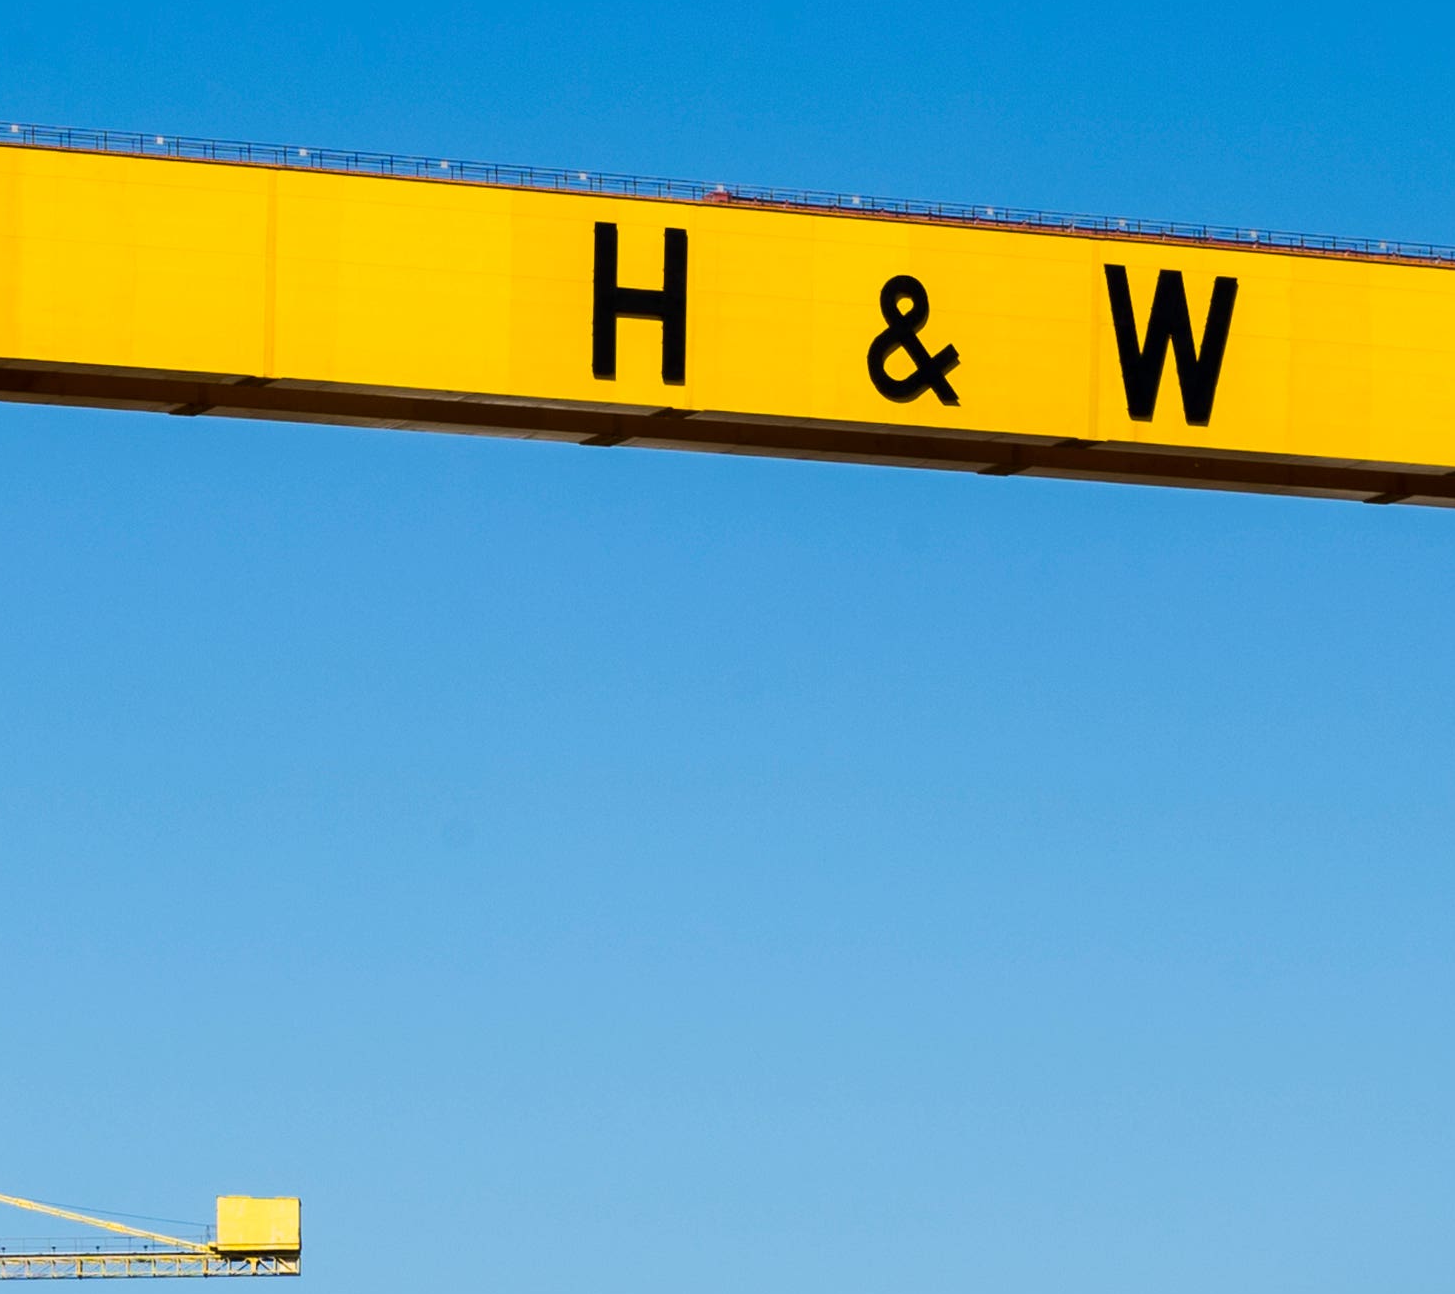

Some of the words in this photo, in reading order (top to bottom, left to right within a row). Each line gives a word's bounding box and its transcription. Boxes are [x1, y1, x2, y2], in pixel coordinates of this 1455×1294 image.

[592, 221, 688, 387] H
[867, 274, 961, 407] &
[1104, 263, 1239, 427] W
